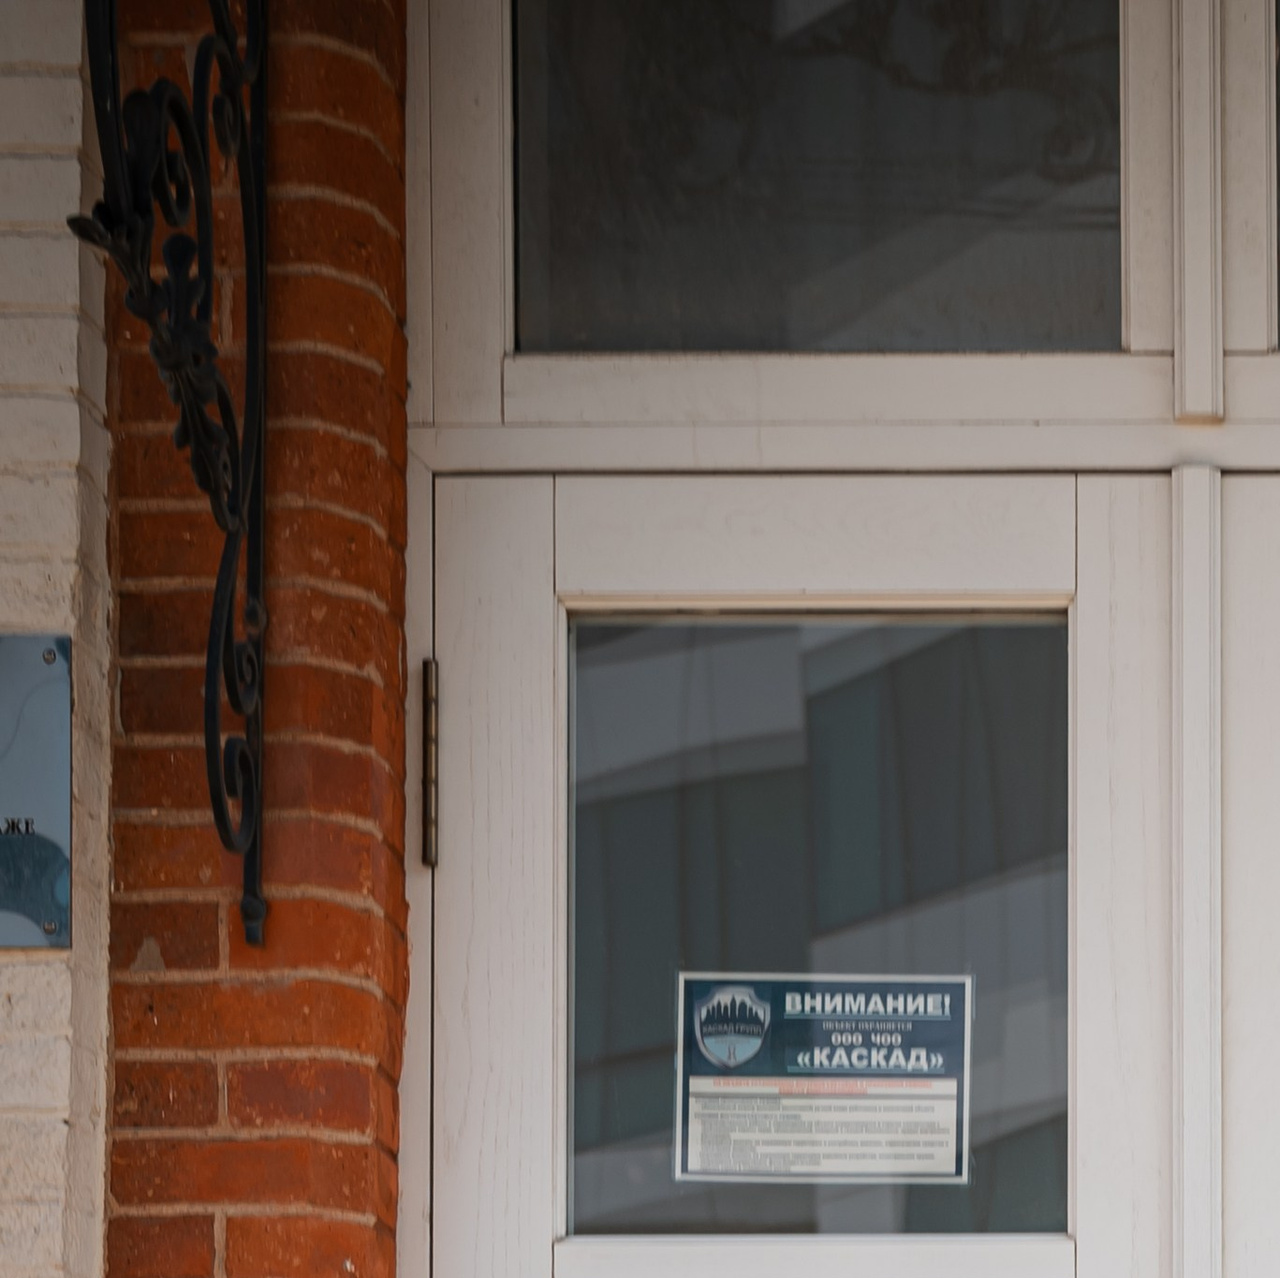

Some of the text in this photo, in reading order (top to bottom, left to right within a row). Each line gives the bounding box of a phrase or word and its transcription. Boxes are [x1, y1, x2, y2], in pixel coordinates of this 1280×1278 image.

[0, 817, 36, 835] ЖЕ
[785, 991, 951, 1016] ВНИМАНИЕ!
[831, 1032, 863, 1046] ООО
[796, 1046, 944, 1072] «КАСКАД»
